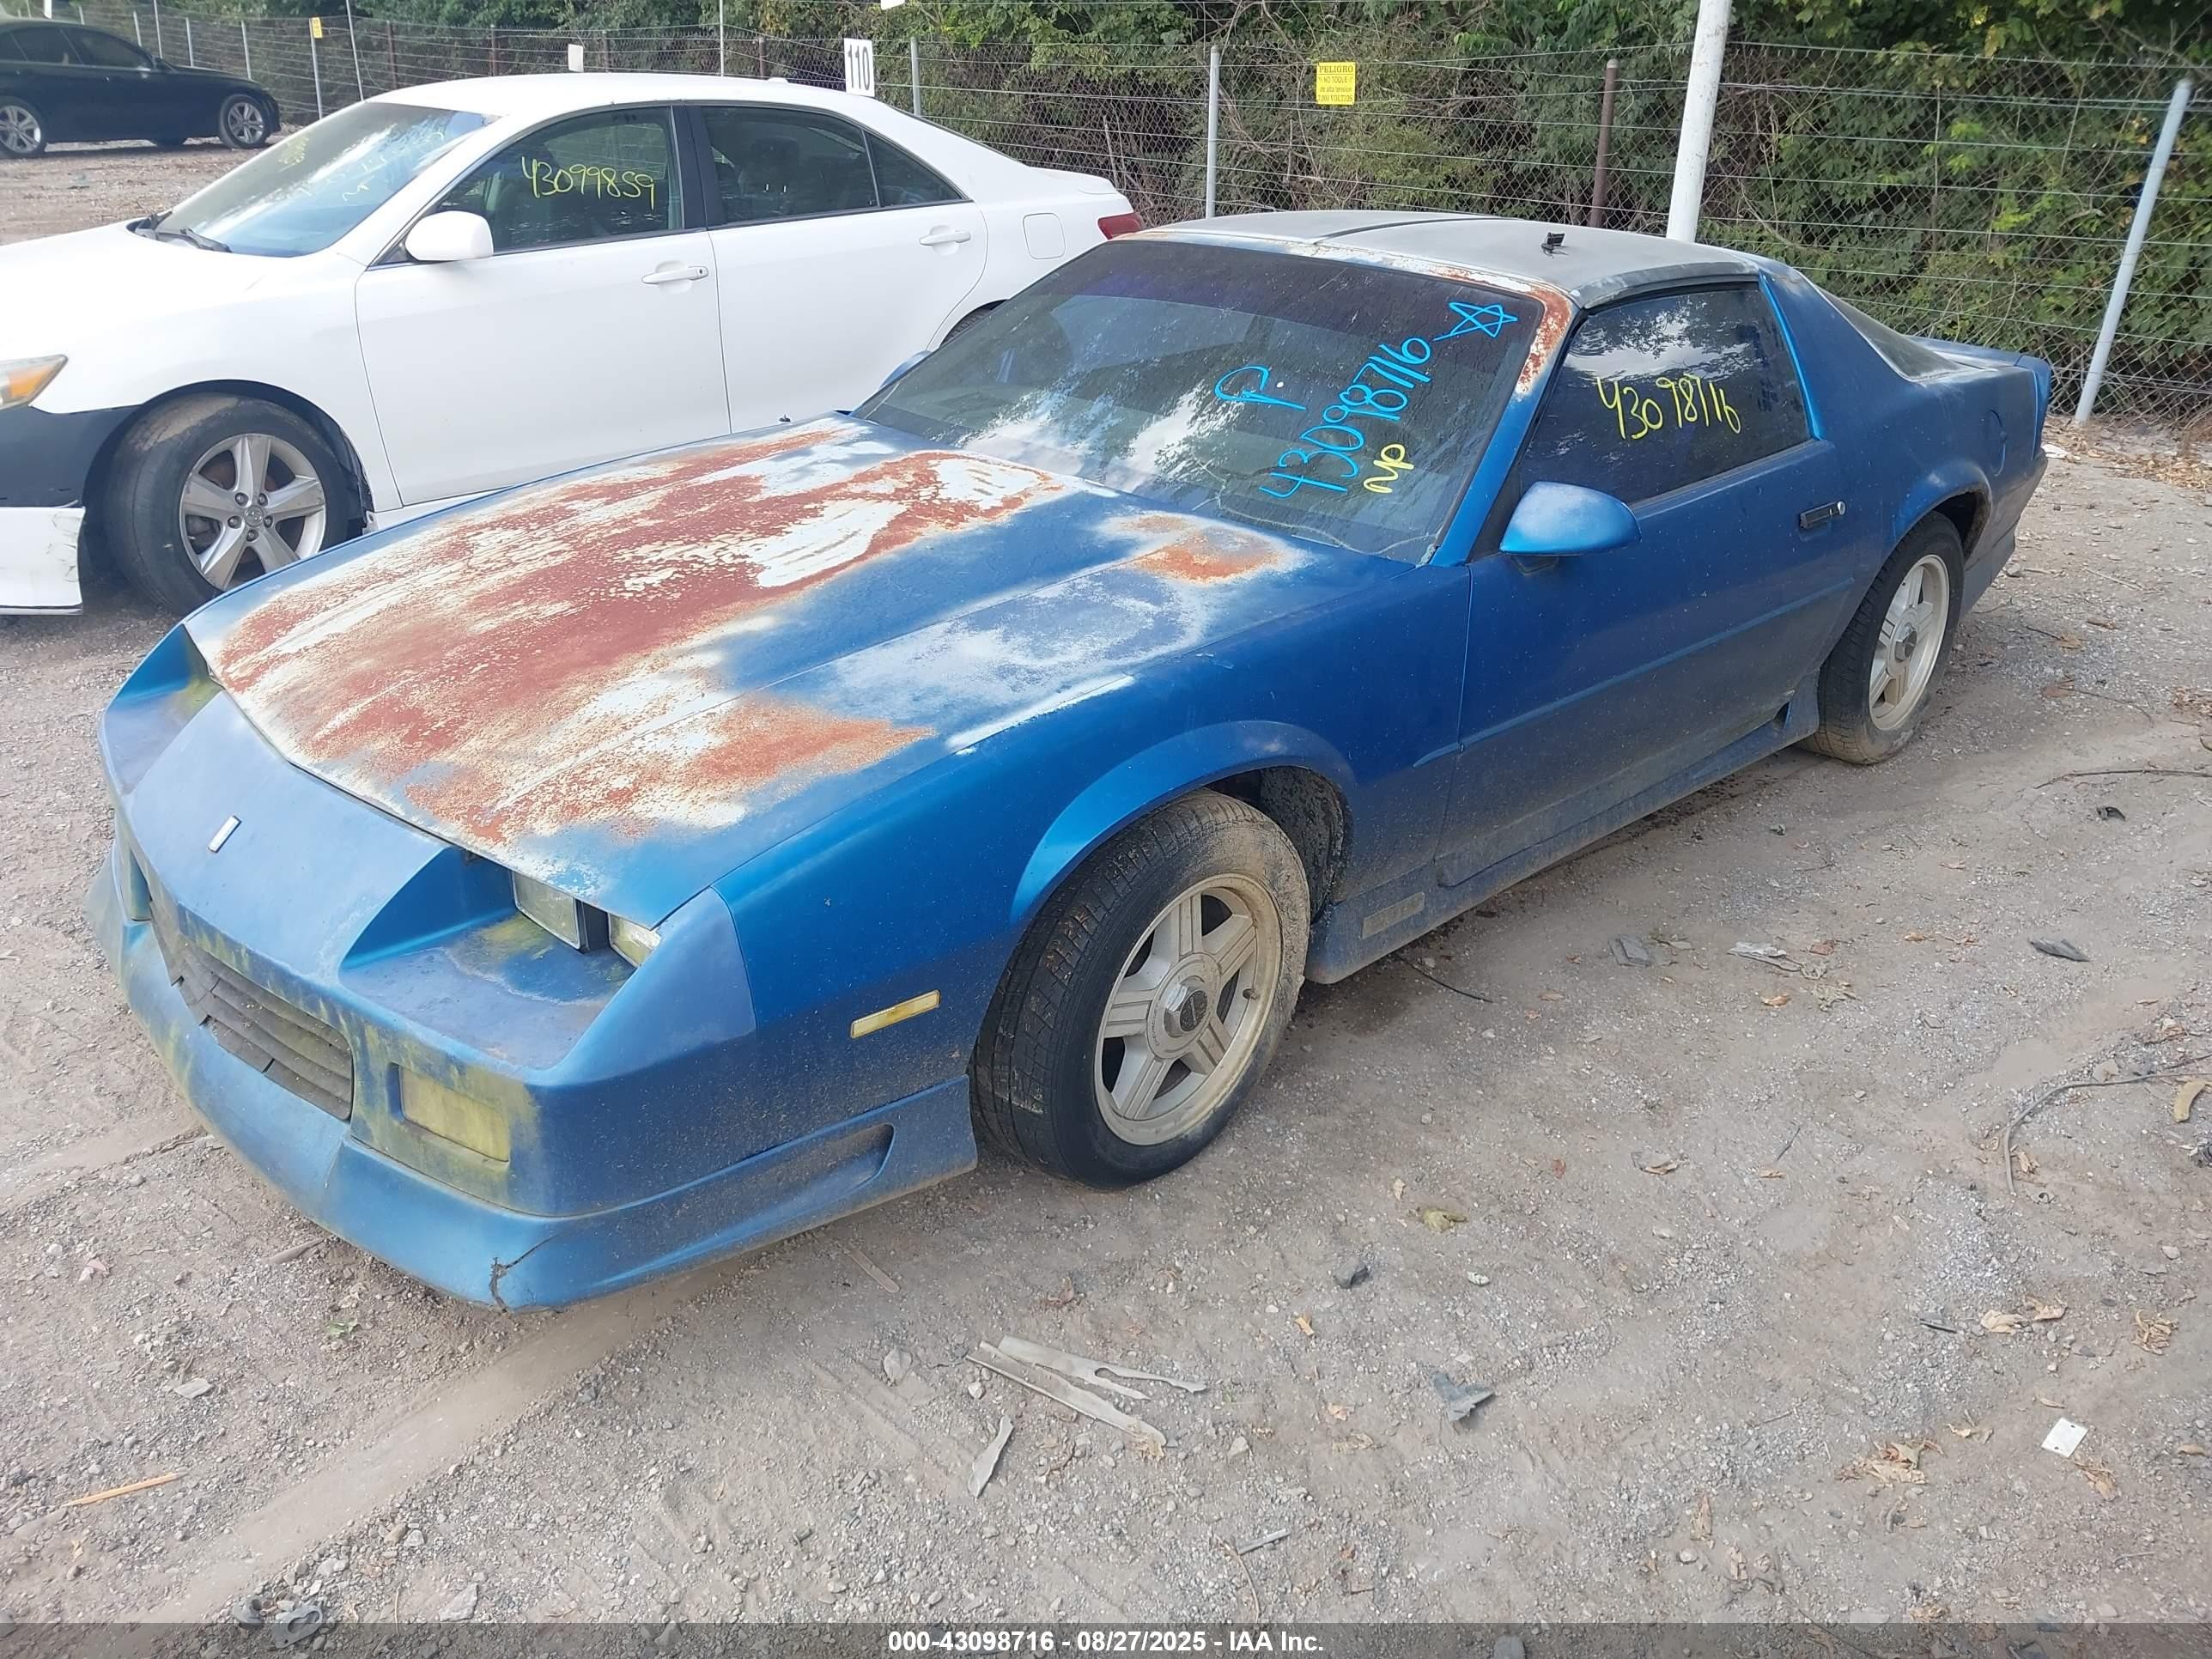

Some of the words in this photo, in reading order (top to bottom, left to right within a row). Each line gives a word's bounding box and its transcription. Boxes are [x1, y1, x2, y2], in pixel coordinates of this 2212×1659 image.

[848, 45, 870, 91] 110
[1319, 64, 1353, 73] PELIGRO
[521, 156, 655, 210] 43099859
[1258, 337, 1432, 499] 43098716
[1596, 373, 1741, 441] 43098716
